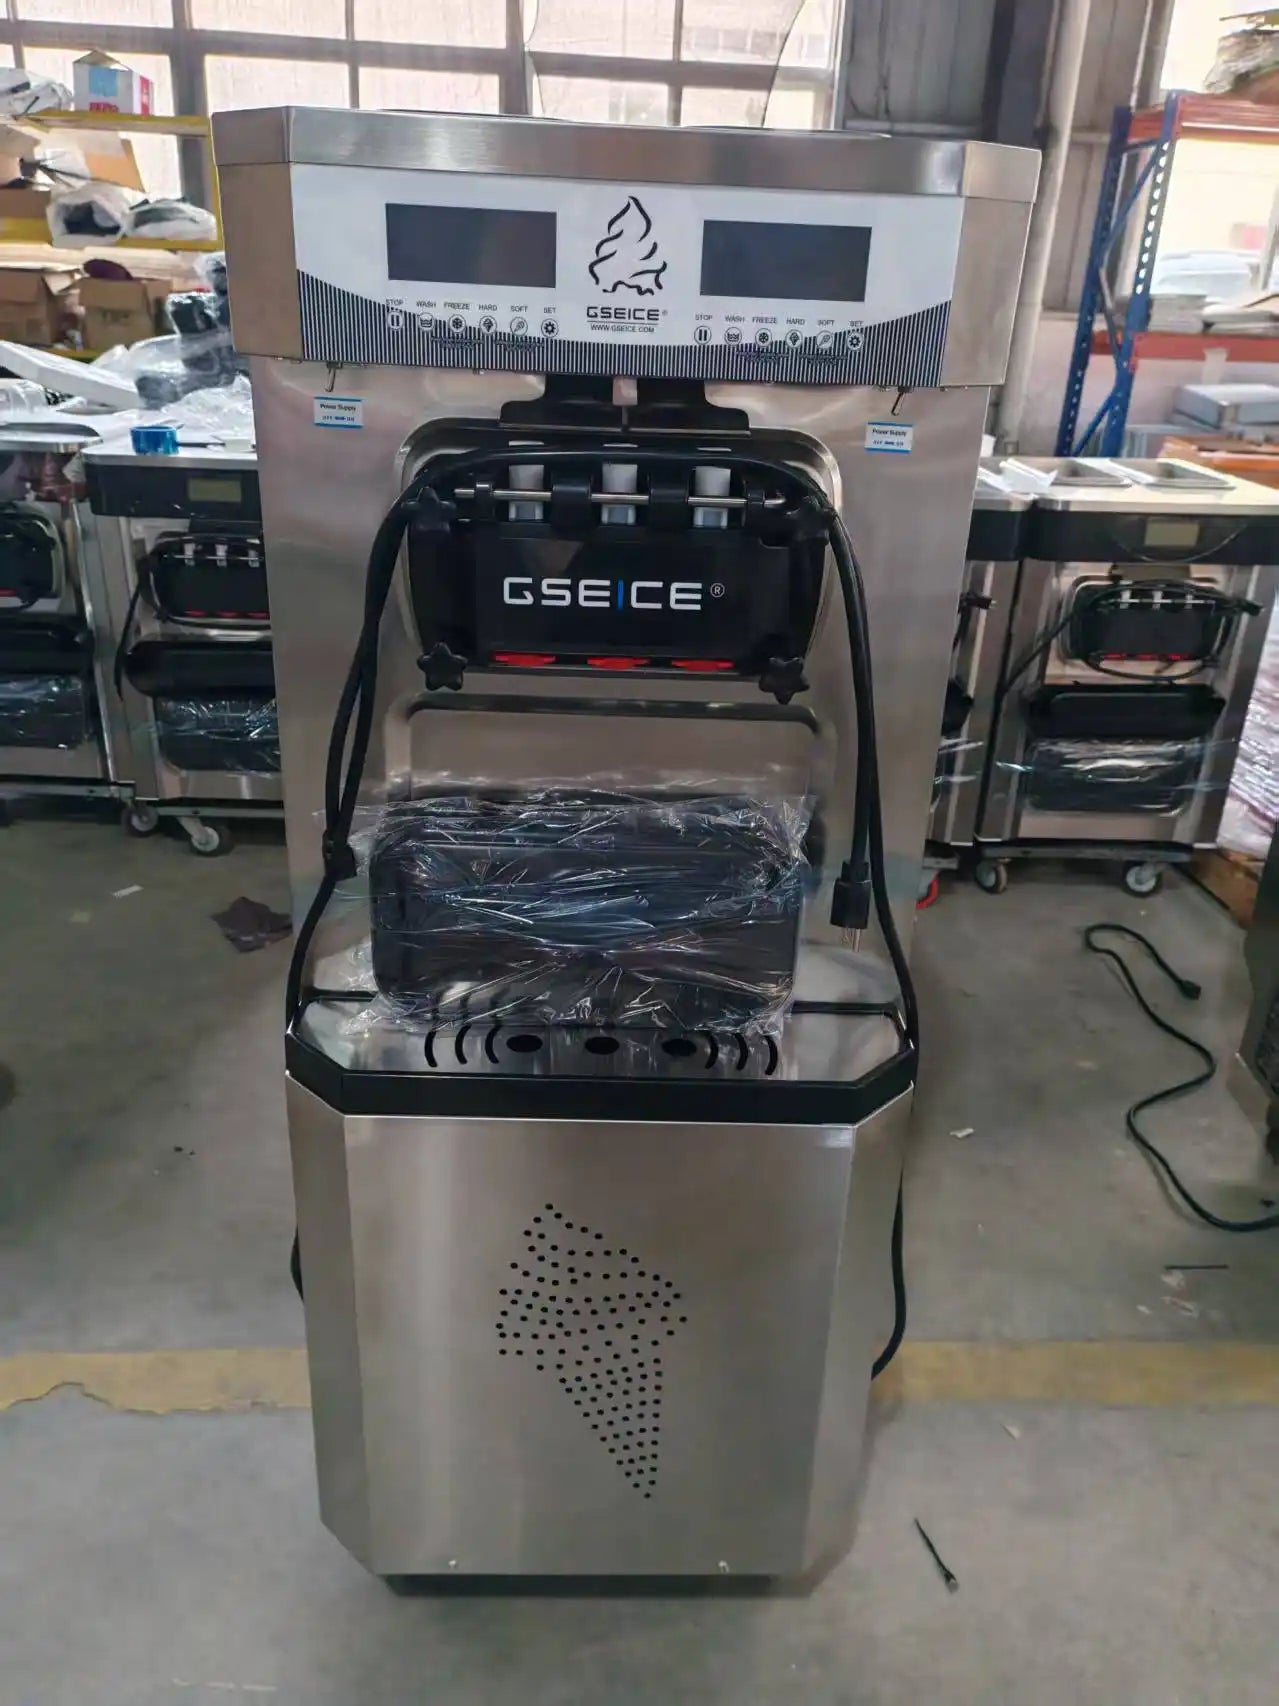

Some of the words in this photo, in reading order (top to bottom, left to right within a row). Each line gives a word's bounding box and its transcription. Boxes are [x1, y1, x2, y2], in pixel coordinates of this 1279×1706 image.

[386, 299, 404, 307] STOP
[416, 300, 437, 309] WASH
[444, 302, 470, 311] FREEZE
[510, 305, 528, 313] SOFT
[725, 315, 745, 323] WASH
[752, 316, 778, 324] FREEZE
[591, 324, 655, 333] WWW.GSEICE.COM
